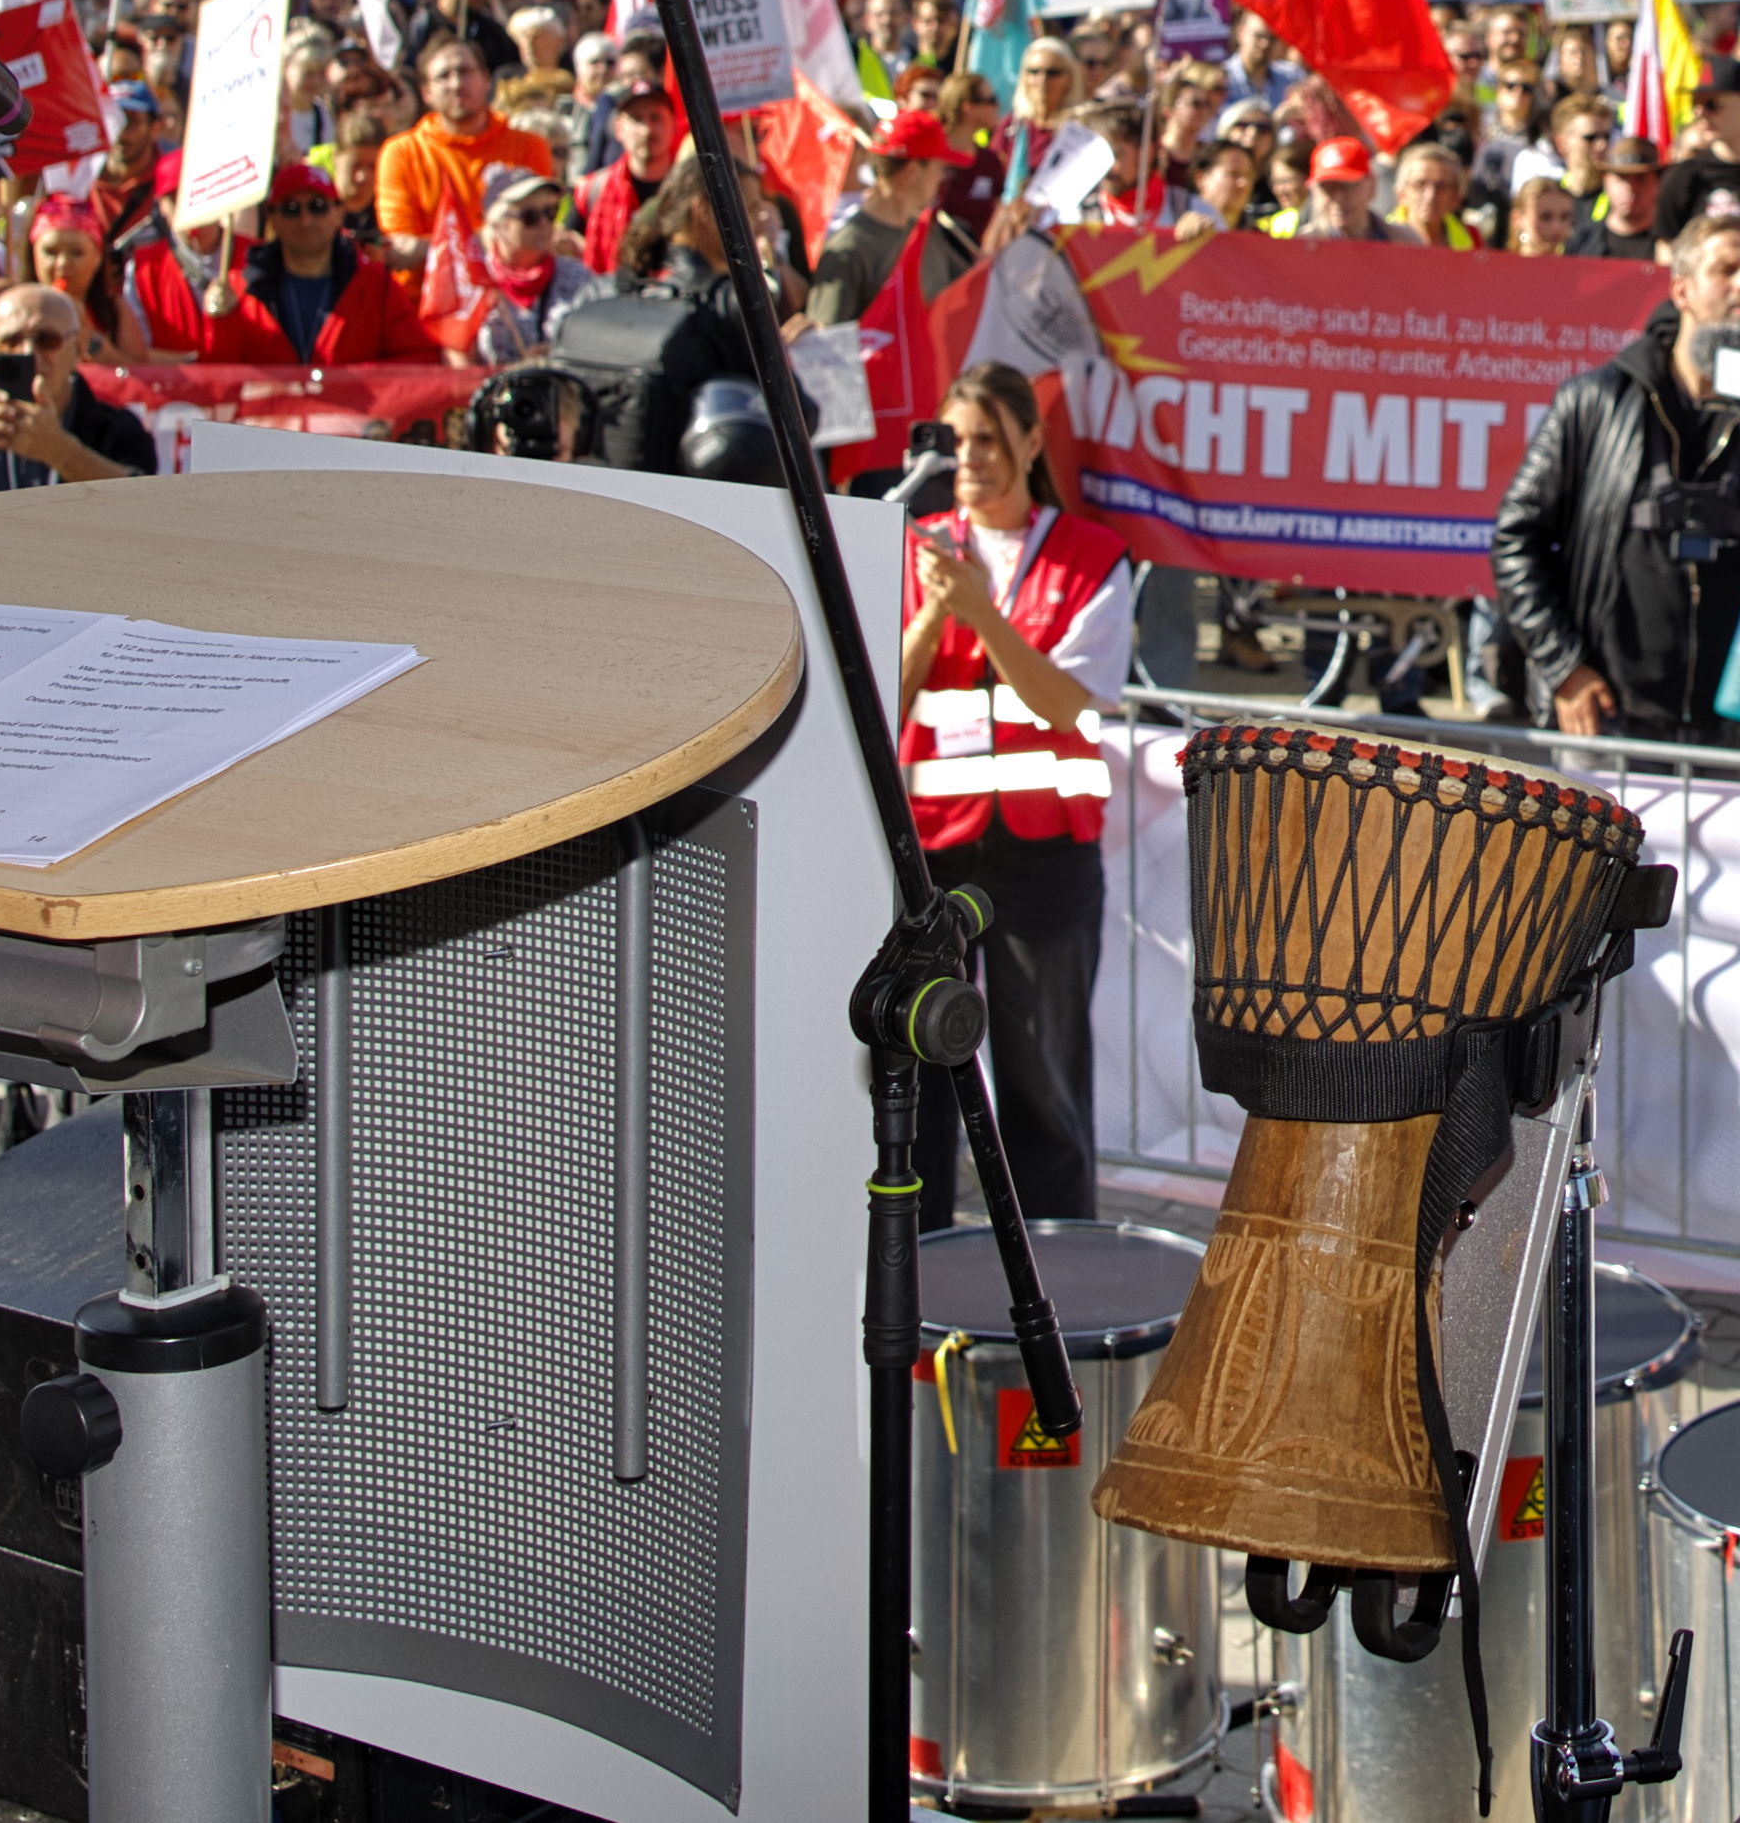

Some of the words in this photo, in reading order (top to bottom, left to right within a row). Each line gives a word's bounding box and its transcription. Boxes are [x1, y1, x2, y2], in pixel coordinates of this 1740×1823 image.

[702, 16, 764, 47] WEG!
[1180, 292, 1317, 334] Beschäftigte
[1321, 299, 1368, 332] sind
[1370, 309, 1402, 334] zu
[1460, 317, 1485, 342] zu
[1178, 330, 1306, 368] Gesetzliche
[1309, 337, 1374, 372] Rente
[1062, 353, 1309, 477] NICHT
[1324, 391, 1505, 491] MIT
[1198, 500, 1335, 544] ERKÄMPFTEN
[136, 646, 169, 654] schafft
[171, 649, 231, 658] Perspektiven
